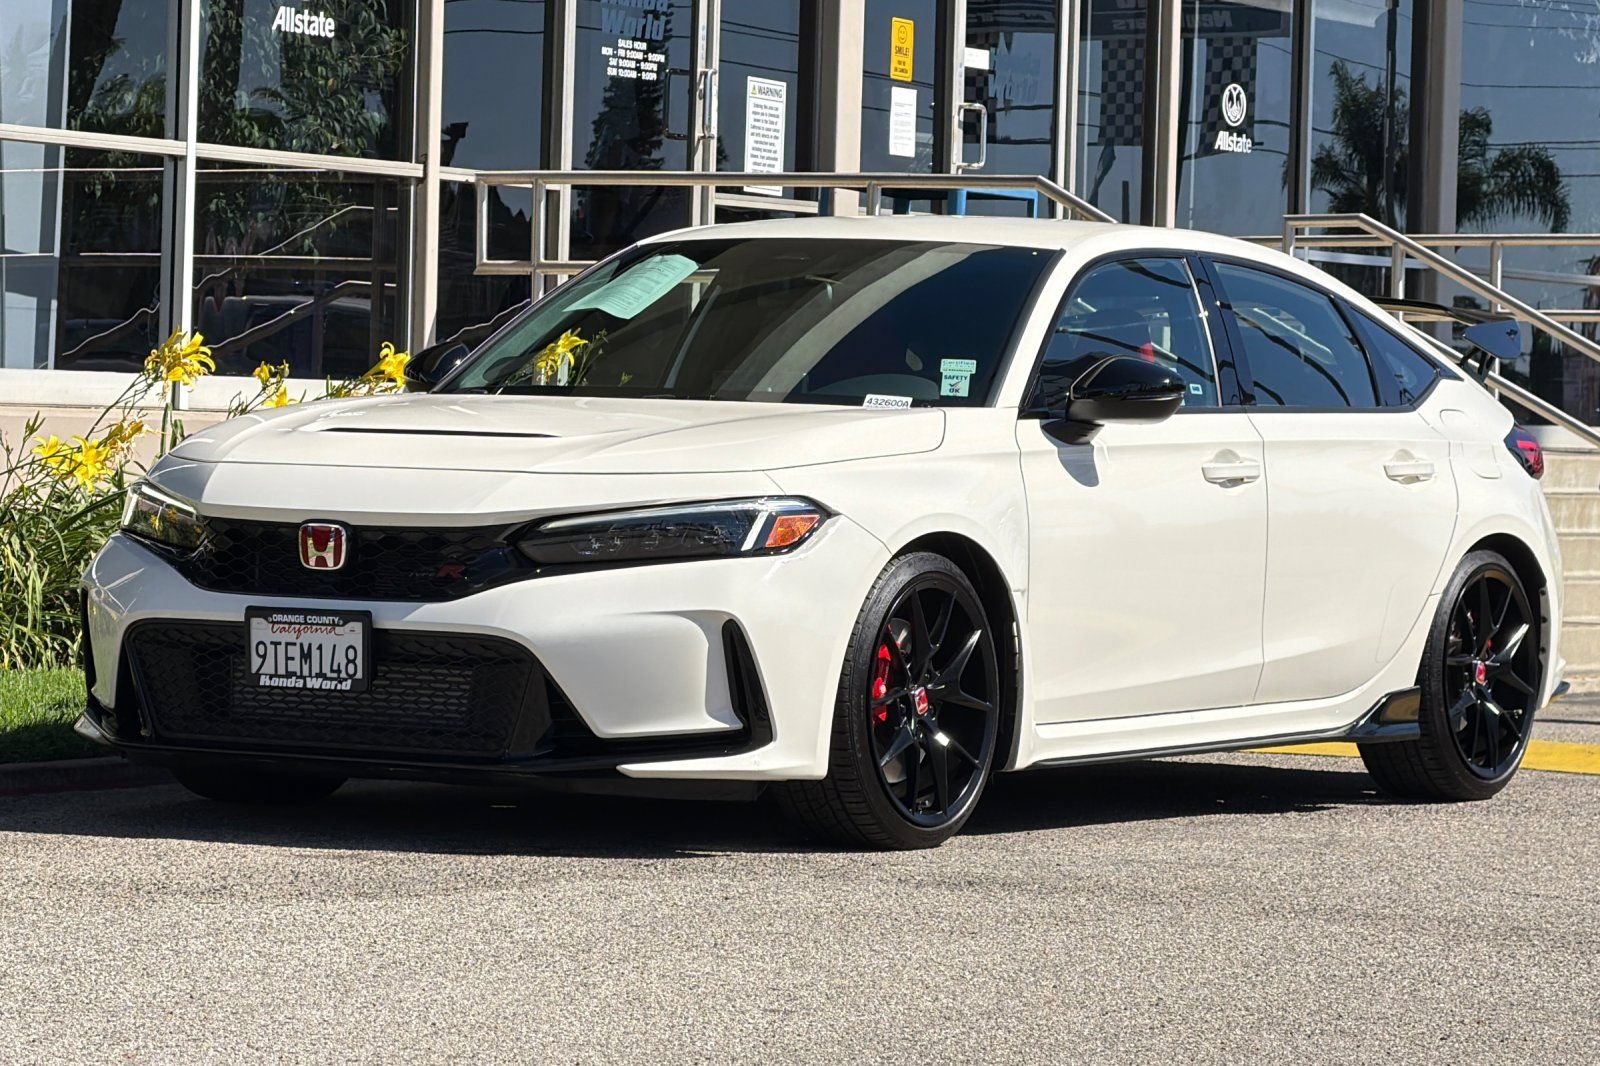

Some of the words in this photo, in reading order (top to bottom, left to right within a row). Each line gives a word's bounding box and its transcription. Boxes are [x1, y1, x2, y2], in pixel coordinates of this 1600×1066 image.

[271, 6, 335, 38] Allstate
[602, 8, 666, 41] World
[757, 85, 783, 99] WARNING
[1214, 130, 1252, 153] Allstate
[866, 397, 909, 407] 432600A
[272, 614, 305, 624] ORANGE
[307, 616, 339, 625] COUNTY
[271, 623, 344, 640] California
[255, 641, 358, 678] 9TEM148
[260, 674, 304, 688] Honda
